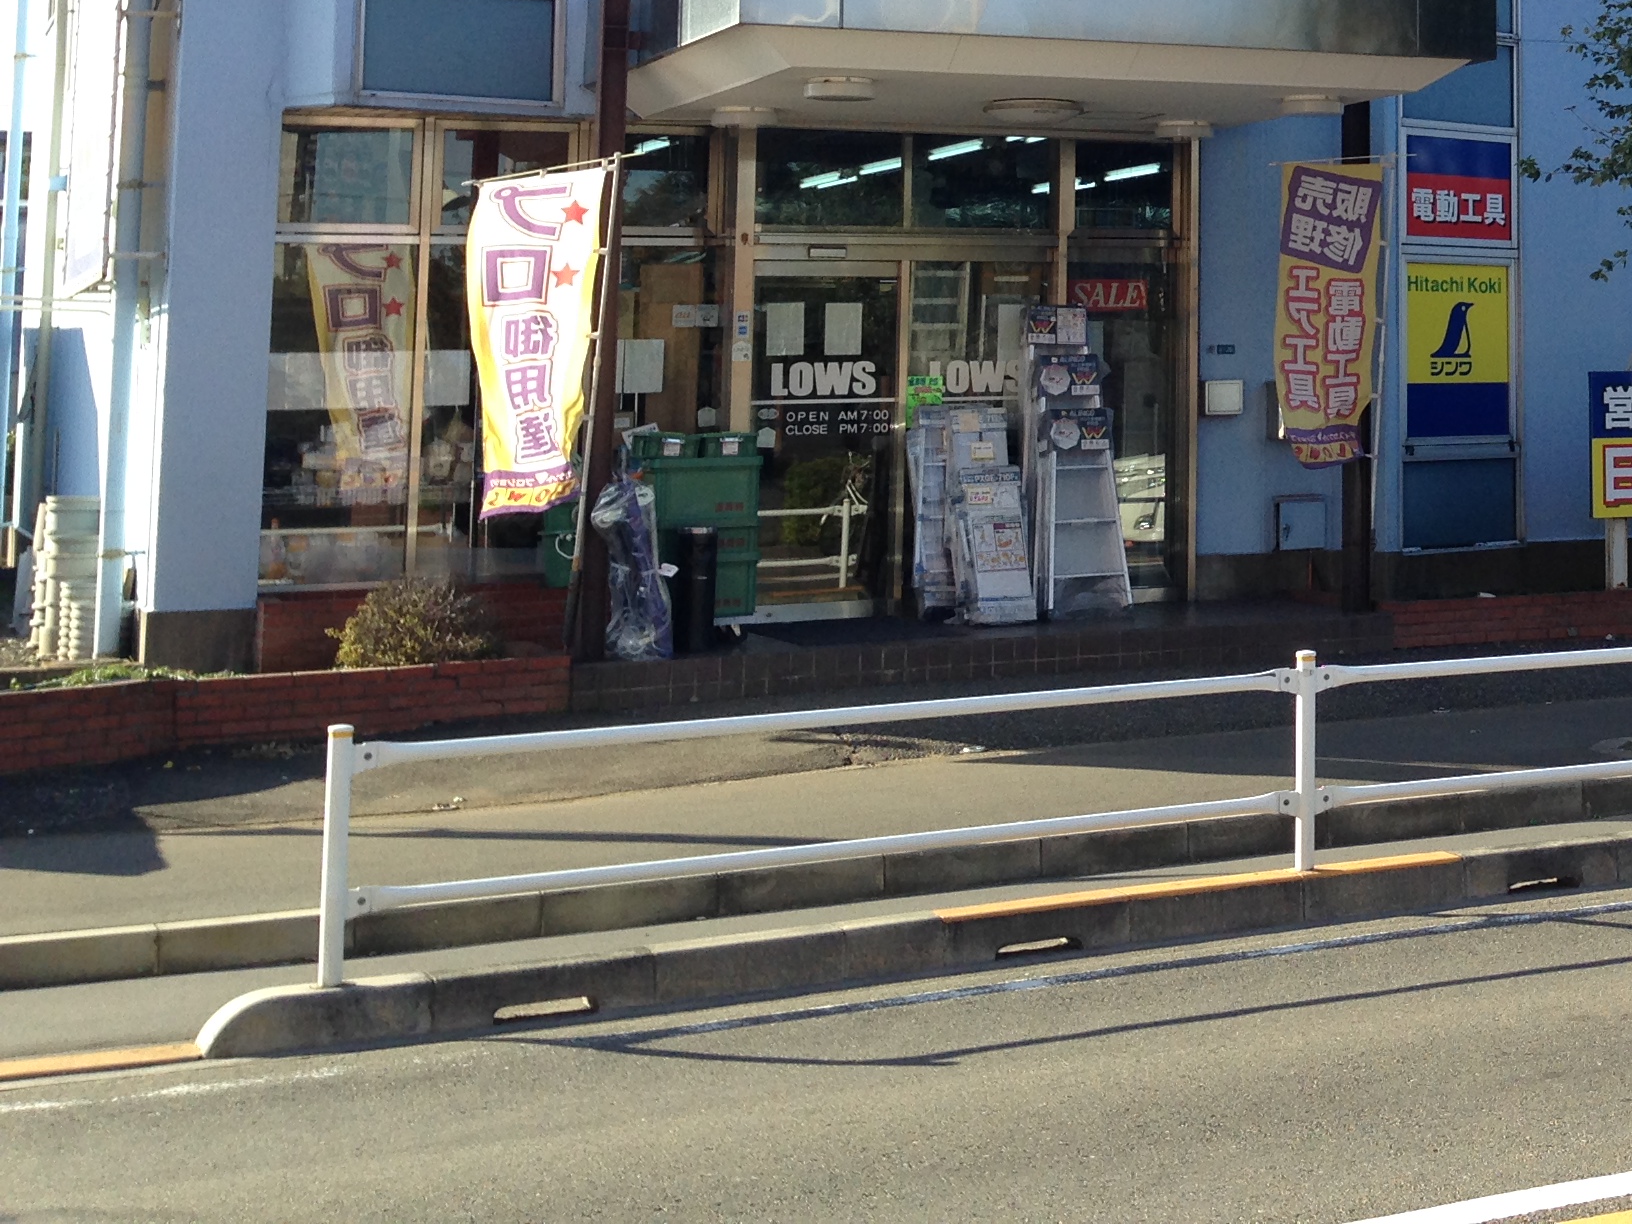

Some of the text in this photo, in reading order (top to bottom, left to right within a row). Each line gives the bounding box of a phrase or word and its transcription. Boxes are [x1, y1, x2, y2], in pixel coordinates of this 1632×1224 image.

[1412, 187, 1507, 226] 電動工具
[1073, 279, 1145, 309] SALE
[1407, 275, 1502, 294] Hitachi Koki
[770, 360, 877, 396] LOWS
[1430, 361, 1473, 376] シンワ
[786, 411, 829, 422] OPEN
[785, 424, 828, 435] CLOSE
